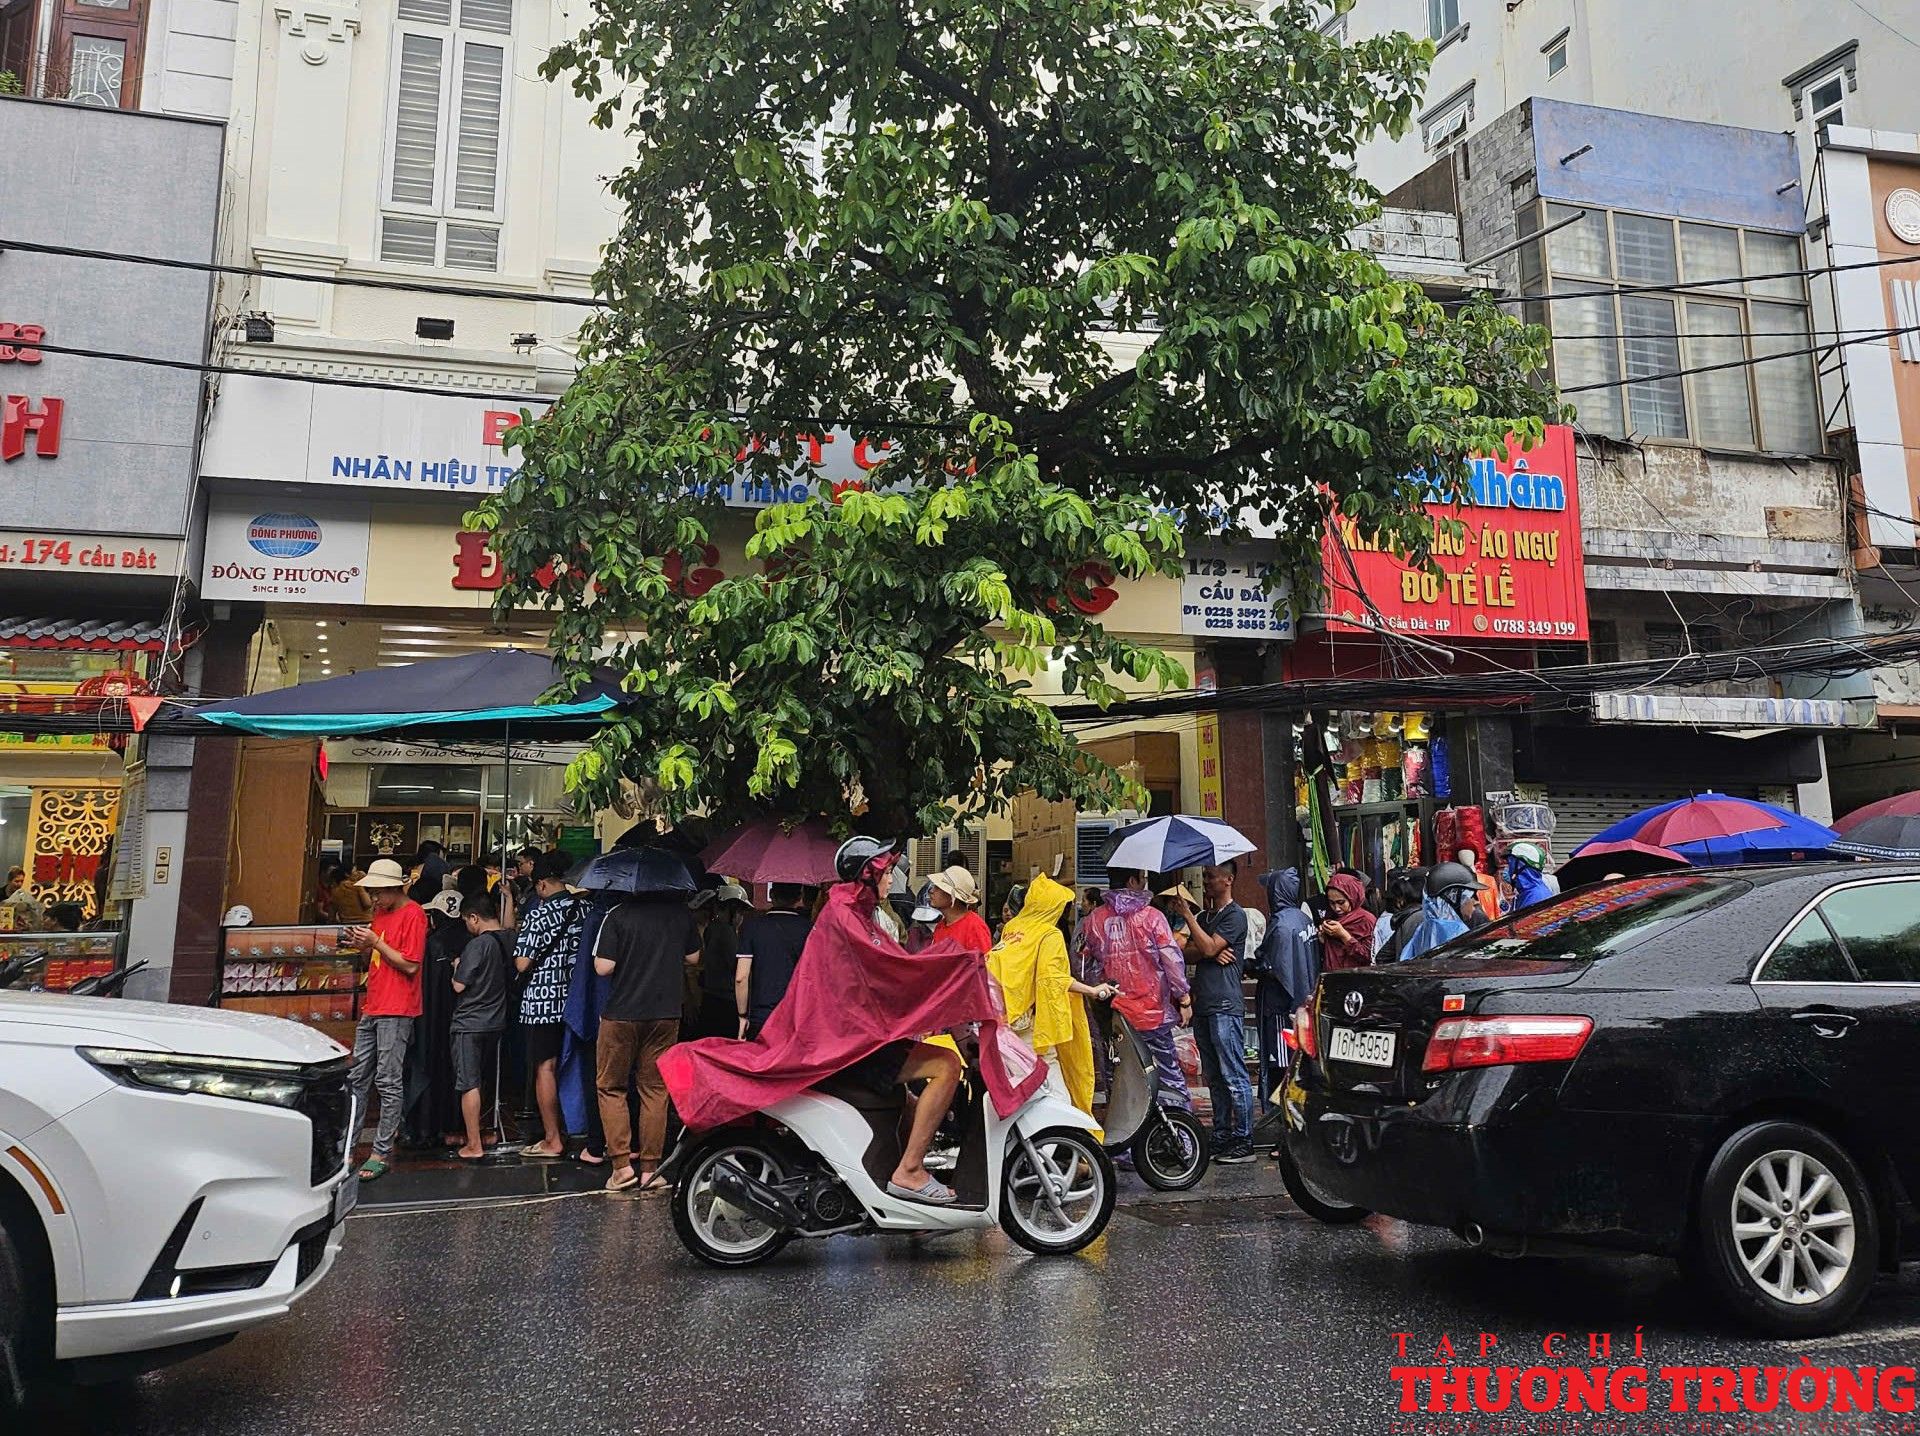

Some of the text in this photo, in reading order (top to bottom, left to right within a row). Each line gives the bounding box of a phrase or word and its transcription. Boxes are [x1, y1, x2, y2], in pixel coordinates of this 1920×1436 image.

[420, 458, 478, 489] HIỆU
[251, 527, 318, 541] ĐÔNG PHƯƠNG
[1481, 522, 1509, 559] ÁO
[1514, 530, 1560, 567] NGỰ
[20, 539, 73, 566] 174
[79, 544, 115, 567] Cầu
[121, 547, 157, 569] Đất
[211, 562, 266, 581] ĐÔNG
[1187, 559, 1227, 576] 172
[252, 586, 307, 595] SINCE 1950
[1446, 562, 1479, 605] TẾ
[1485, 563, 1517, 607] LỄ
[1182, 605, 1202, 616] ĐT:
[1204, 606, 1233, 617] 0225
[1237, 608, 1266, 618] 3592
[1205, 619, 1234, 629] 0225
[1435, 620, 1450, 631] HP
[1493, 619, 1576, 636] 0788 349 199
